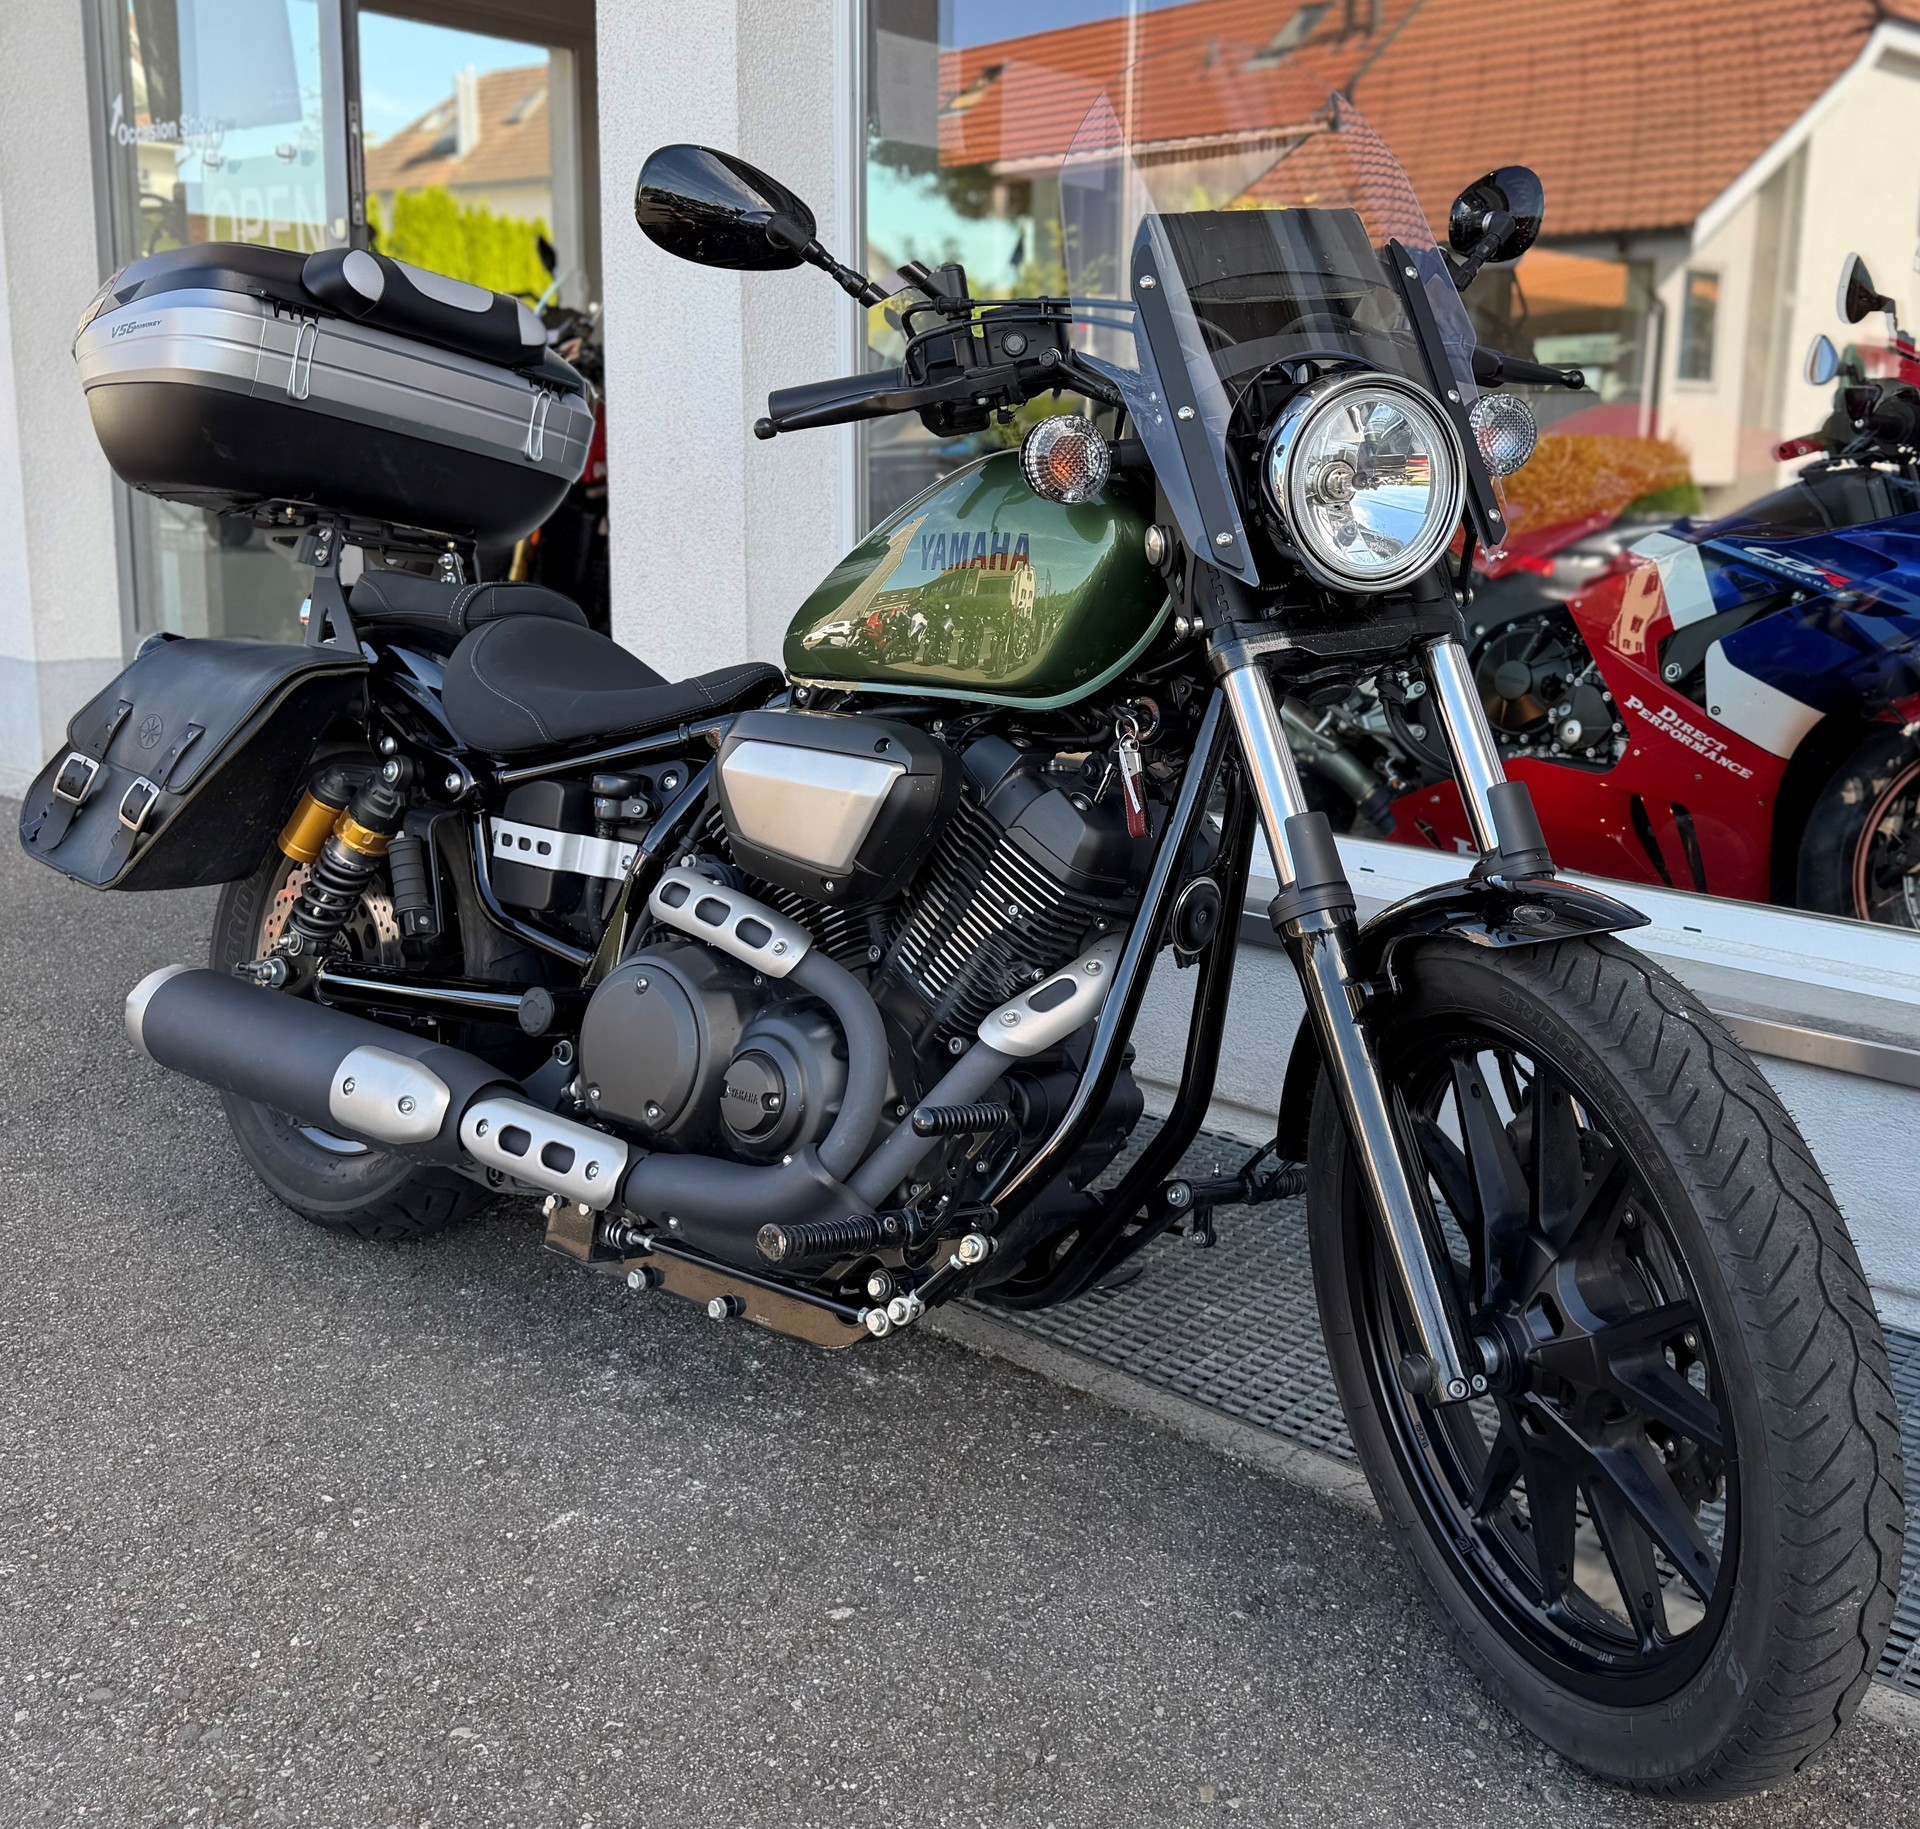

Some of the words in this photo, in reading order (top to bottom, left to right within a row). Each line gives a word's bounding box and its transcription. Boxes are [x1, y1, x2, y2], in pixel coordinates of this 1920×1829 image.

[117, 116, 178, 146] Occasion
[111, 320, 137, 339] V56
[921, 531, 1030, 571] YAMAHA
[1623, 694, 1754, 779] PERFORMANCE
[1656, 704, 1728, 752] DIRECT
[730, 1086, 758, 1105] YAMAHA
[1499, 985, 1667, 1174] BRIDGESTONE
